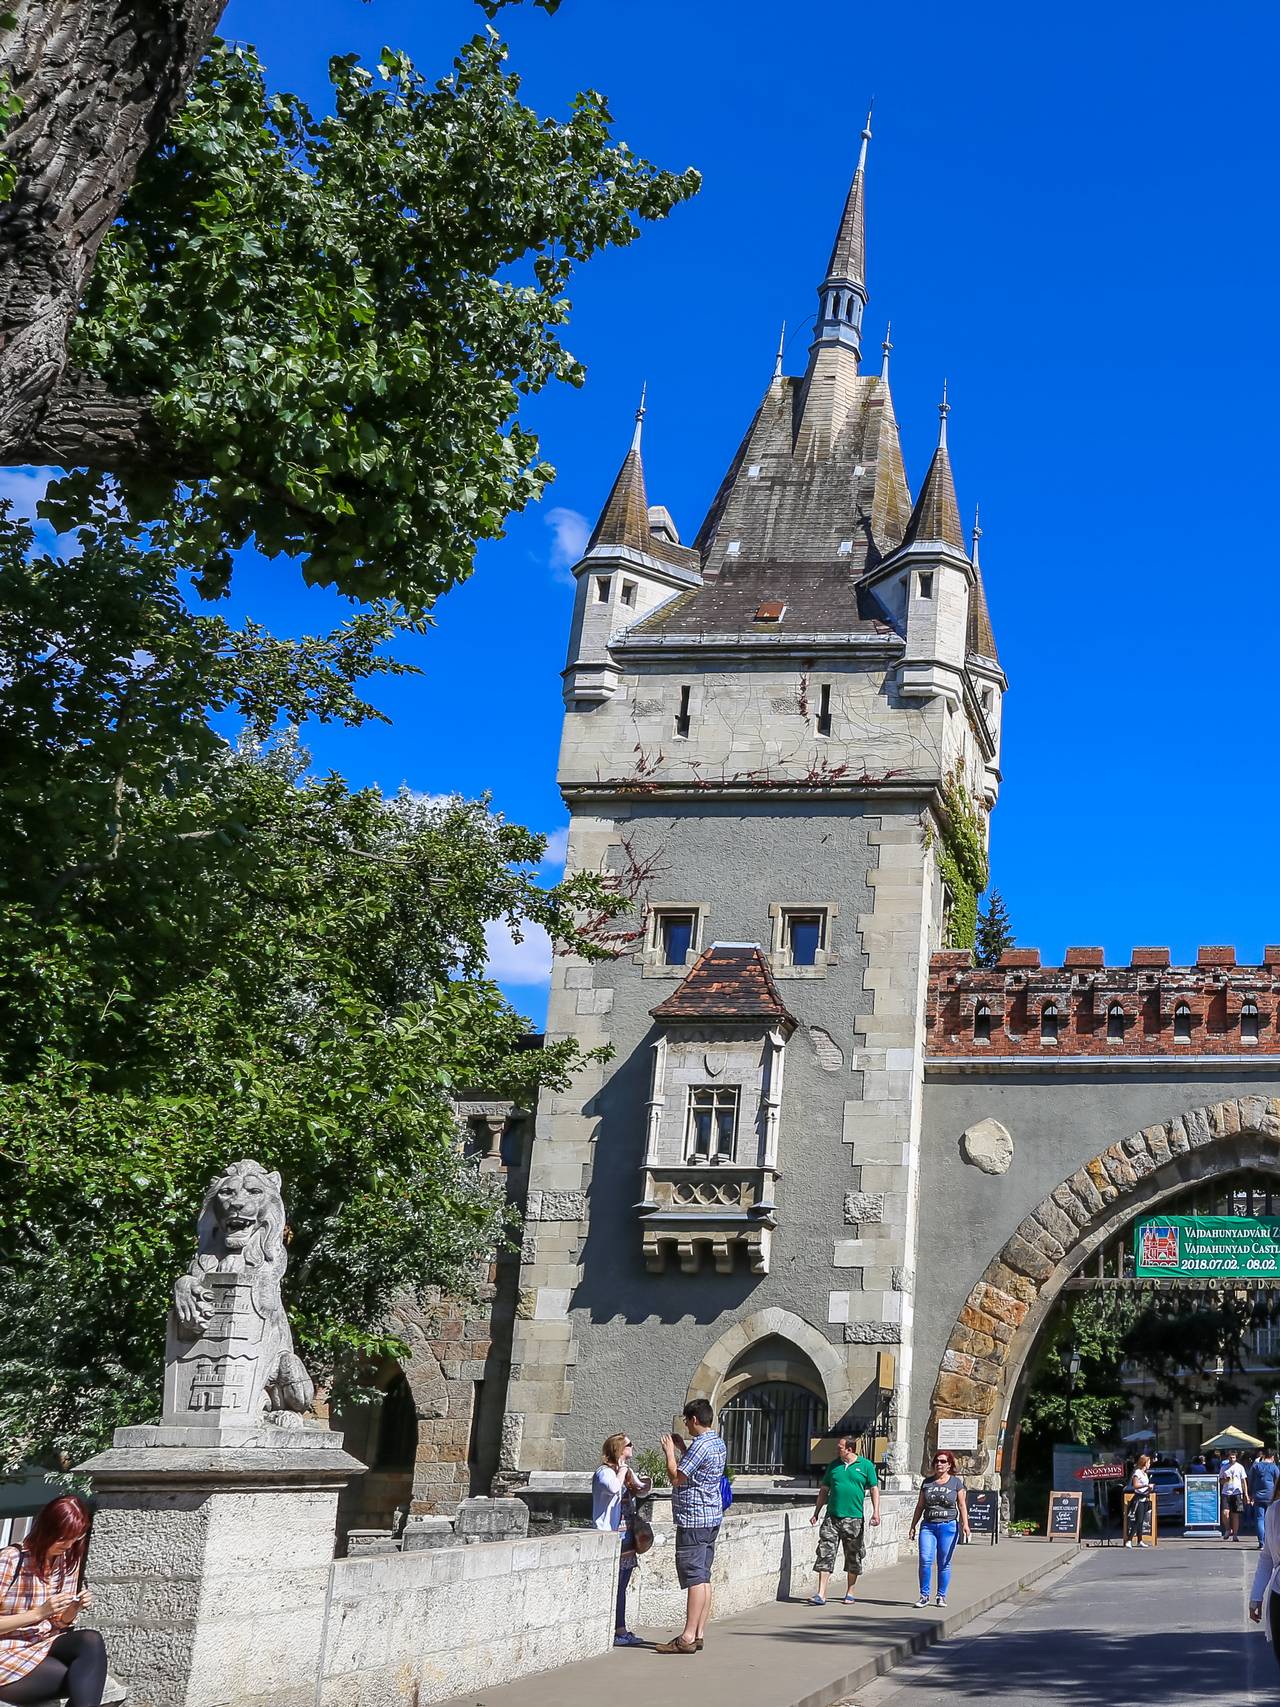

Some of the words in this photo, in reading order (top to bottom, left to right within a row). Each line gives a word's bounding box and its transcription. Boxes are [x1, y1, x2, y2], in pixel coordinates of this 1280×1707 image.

[1184, 1243, 1250, 1255] VAJDAHUNYAD
[1181, 1259, 1240, 1270] 2018.07.02.
[1246, 1259, 1278, 1270] 08.02.
